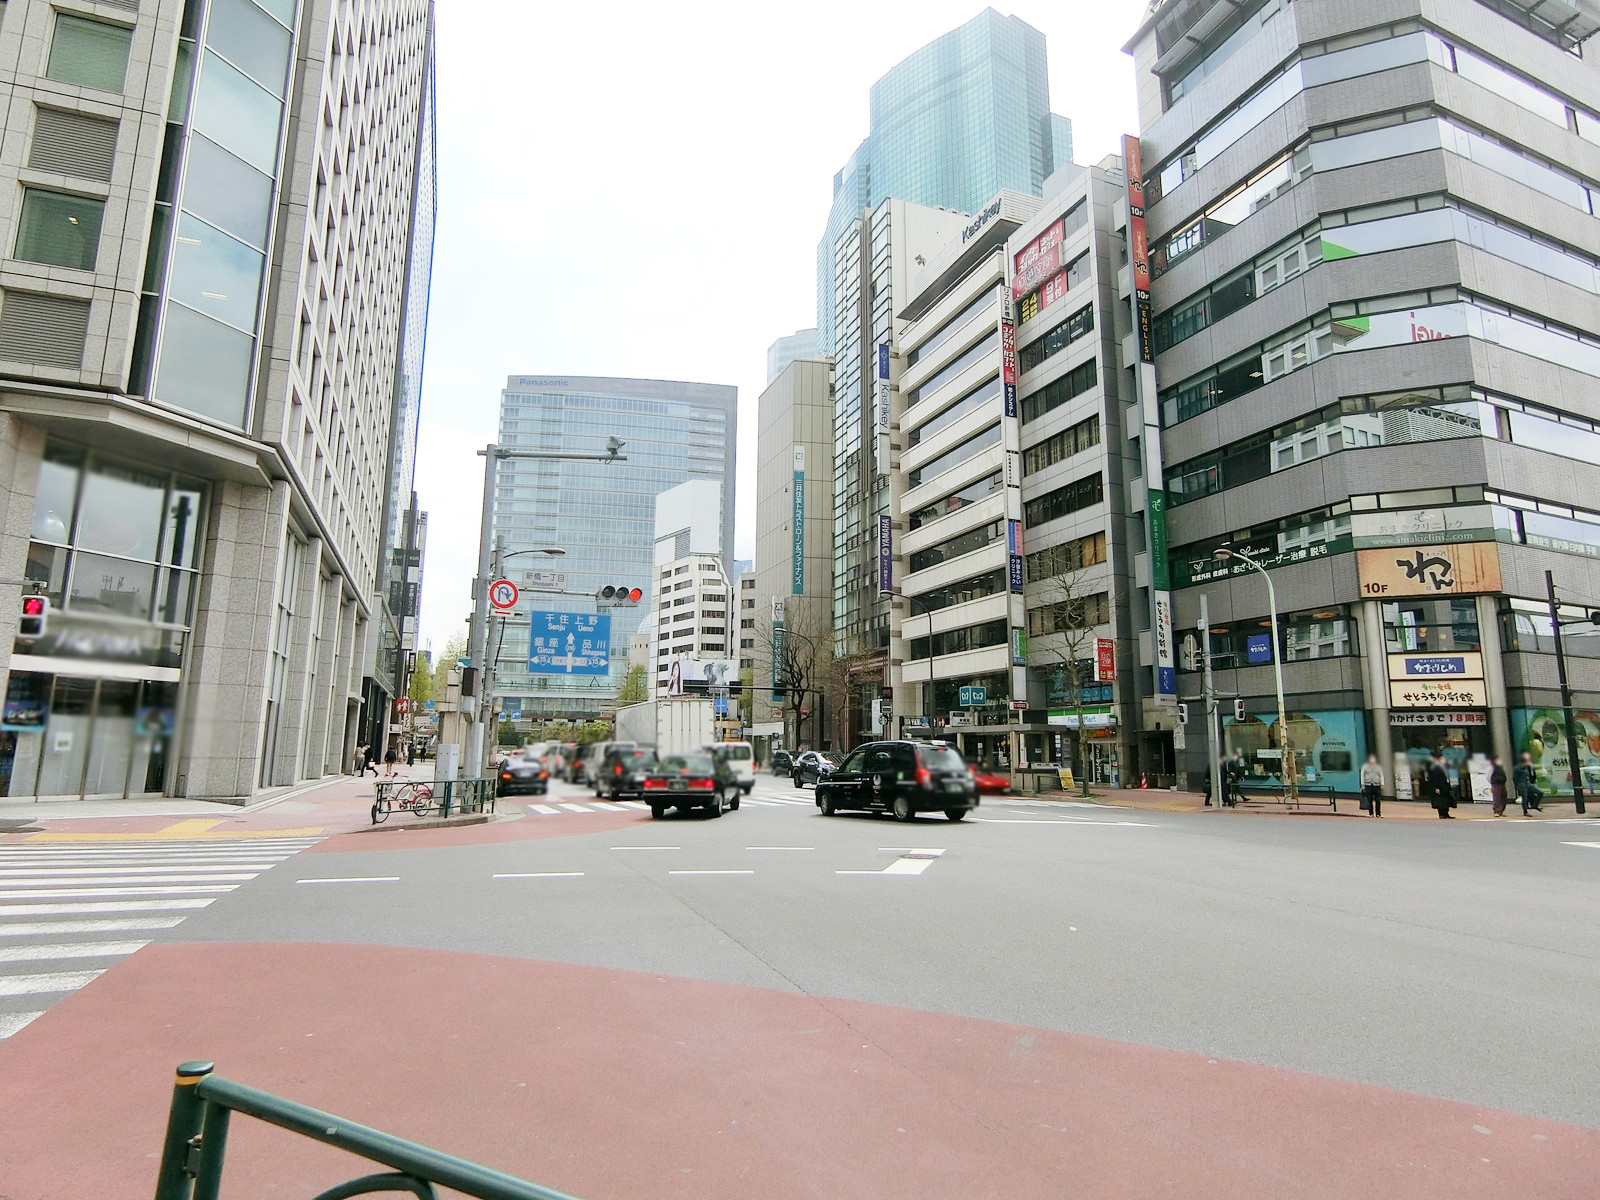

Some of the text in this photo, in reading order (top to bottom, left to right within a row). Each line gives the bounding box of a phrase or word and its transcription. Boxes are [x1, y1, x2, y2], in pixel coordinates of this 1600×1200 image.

[962, 198, 1001, 244] Kashikey
[1046, 274, 1061, 294] 9F
[1141, 310, 1150, 361] ENGLISH
[519, 377, 569, 387] Panasonic
[880, 384, 889, 428] Kashikey
[882, 518, 890, 547] YAMAHA
[1395, 550, 1454, 590] わん
[526, 571, 565, 582] 新橋一丁目
[1363, 582, 1388, 594] 10F
[545, 613, 599, 626] 千住 上野
[547, 623, 594, 633] Senju Ueno
[534, 636, 559, 648] 銀座
[582, 639, 606, 649] 品川
[537, 646, 556, 655] Ginza
[1403, 691, 1474, 703] せとうち旬彩館
[1067, 715, 1096, 725] FamMart
[1448, 713, 1486, 723] 18周年
